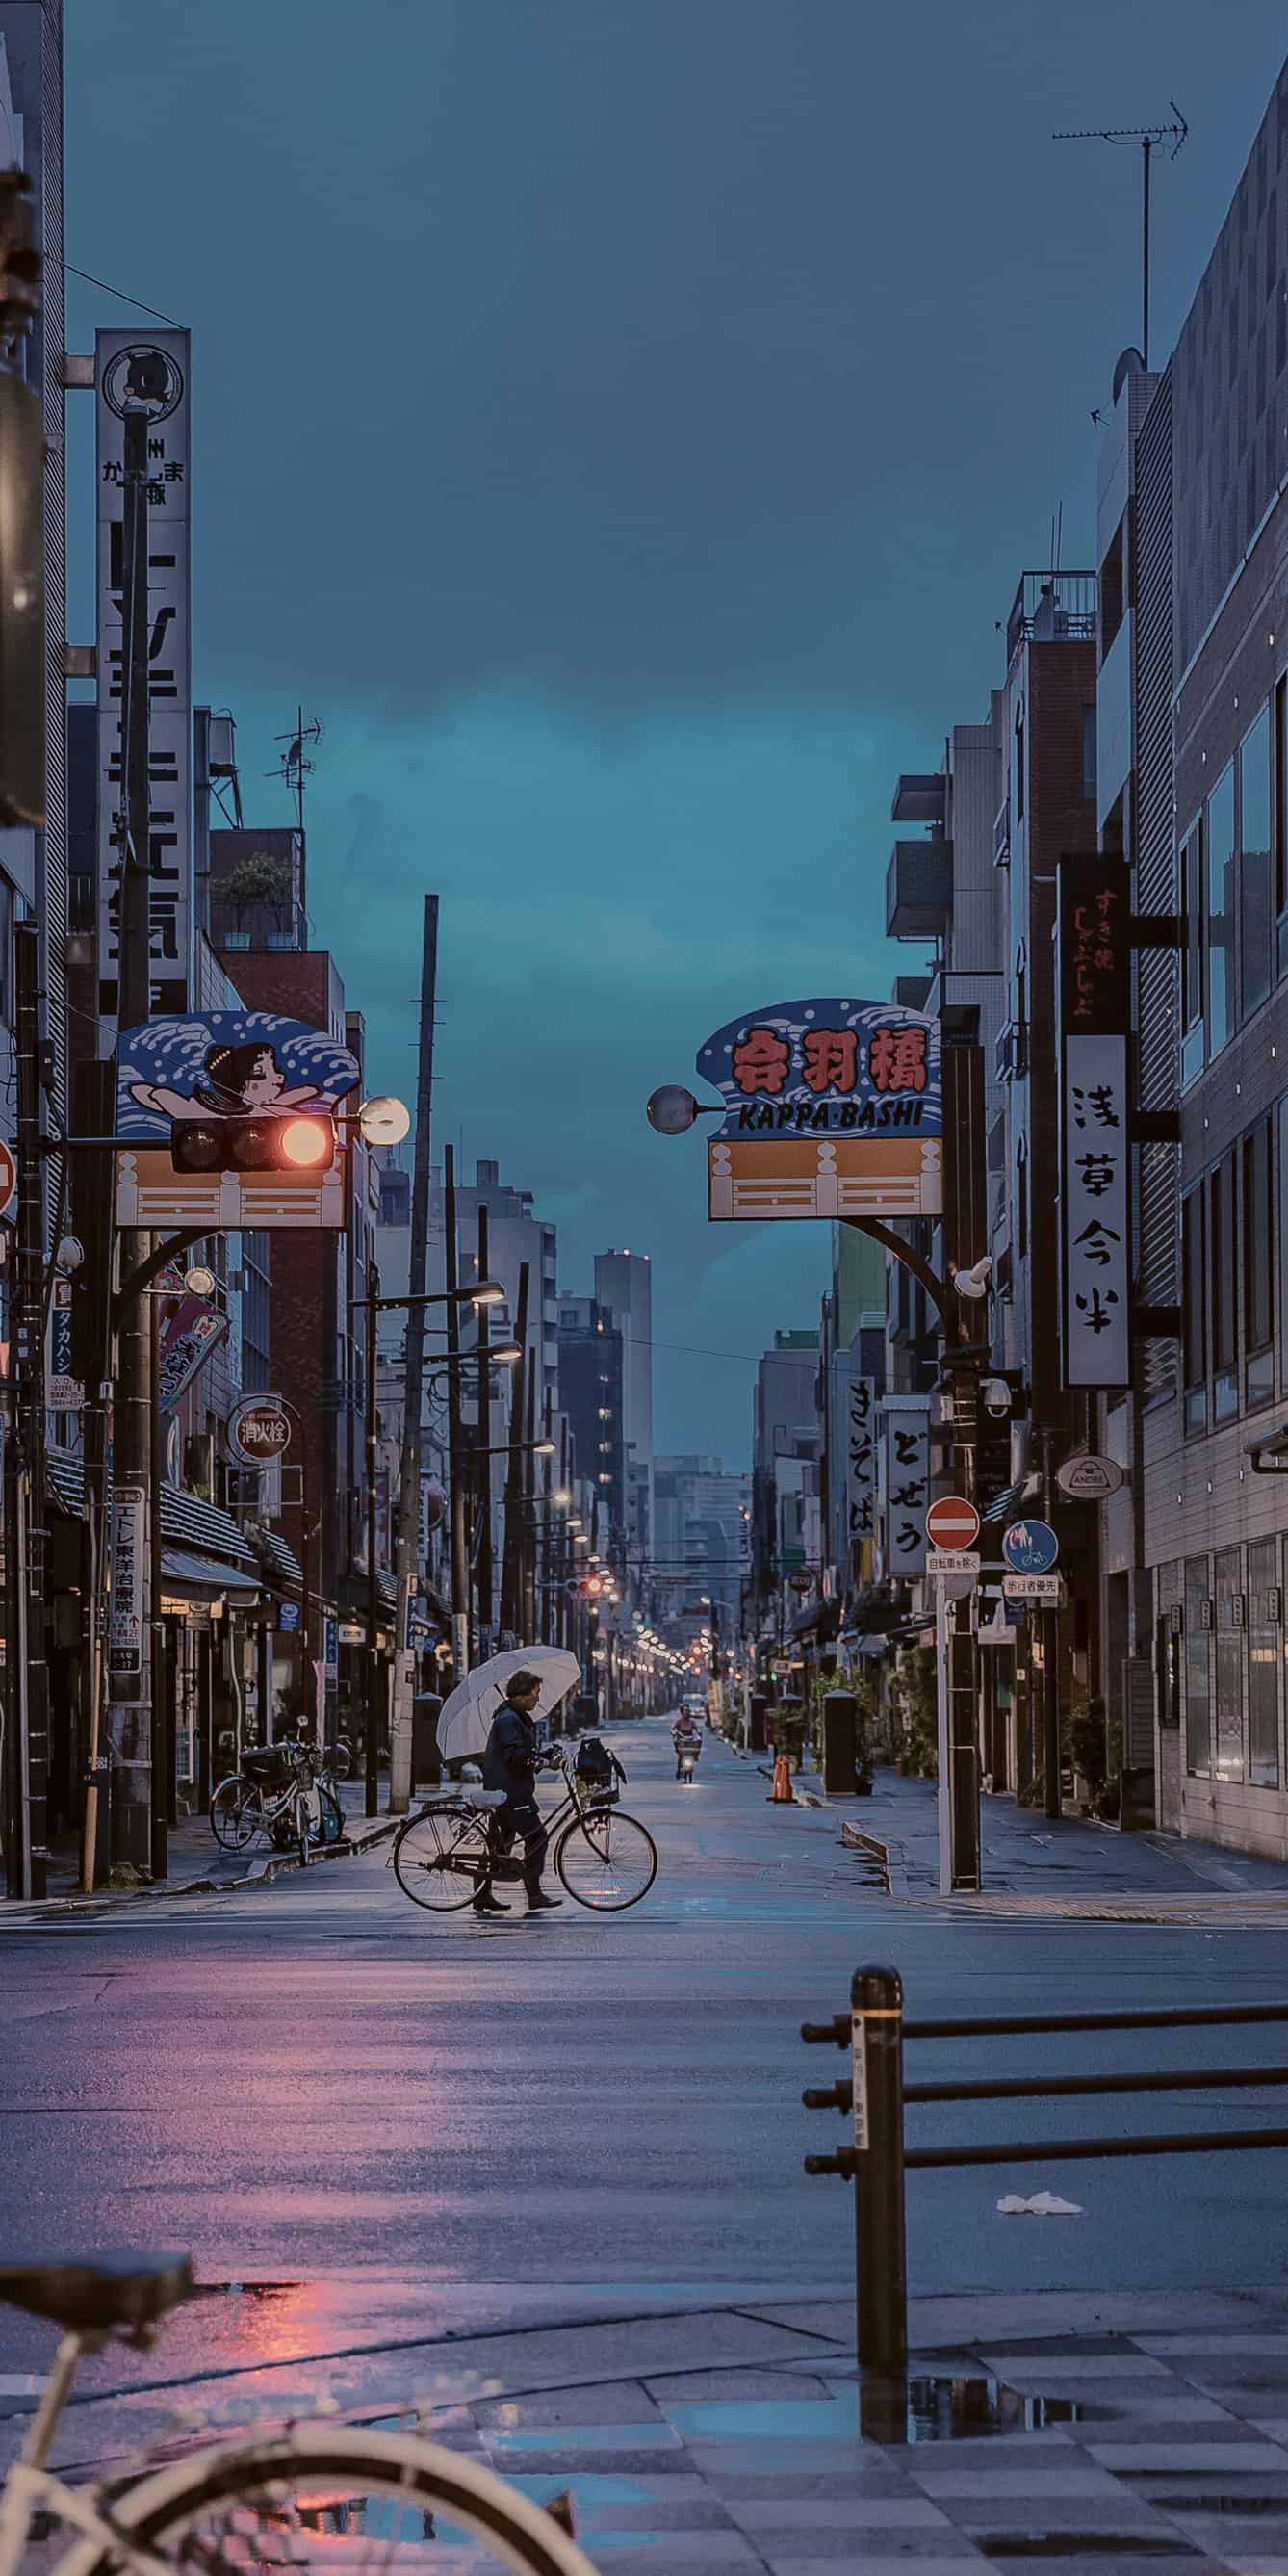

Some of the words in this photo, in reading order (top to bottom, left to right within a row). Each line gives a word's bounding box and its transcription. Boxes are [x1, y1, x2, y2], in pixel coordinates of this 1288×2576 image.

[734, 1028, 928, 1094] 合羽橋
[1072, 1085, 1121, 1335] 浅草今半
[241, 1420, 286, 1444] 消火栓
[890, 1431, 927, 1553] どぜう
[1008, 1578, 1056, 1593] 歩行者優先
